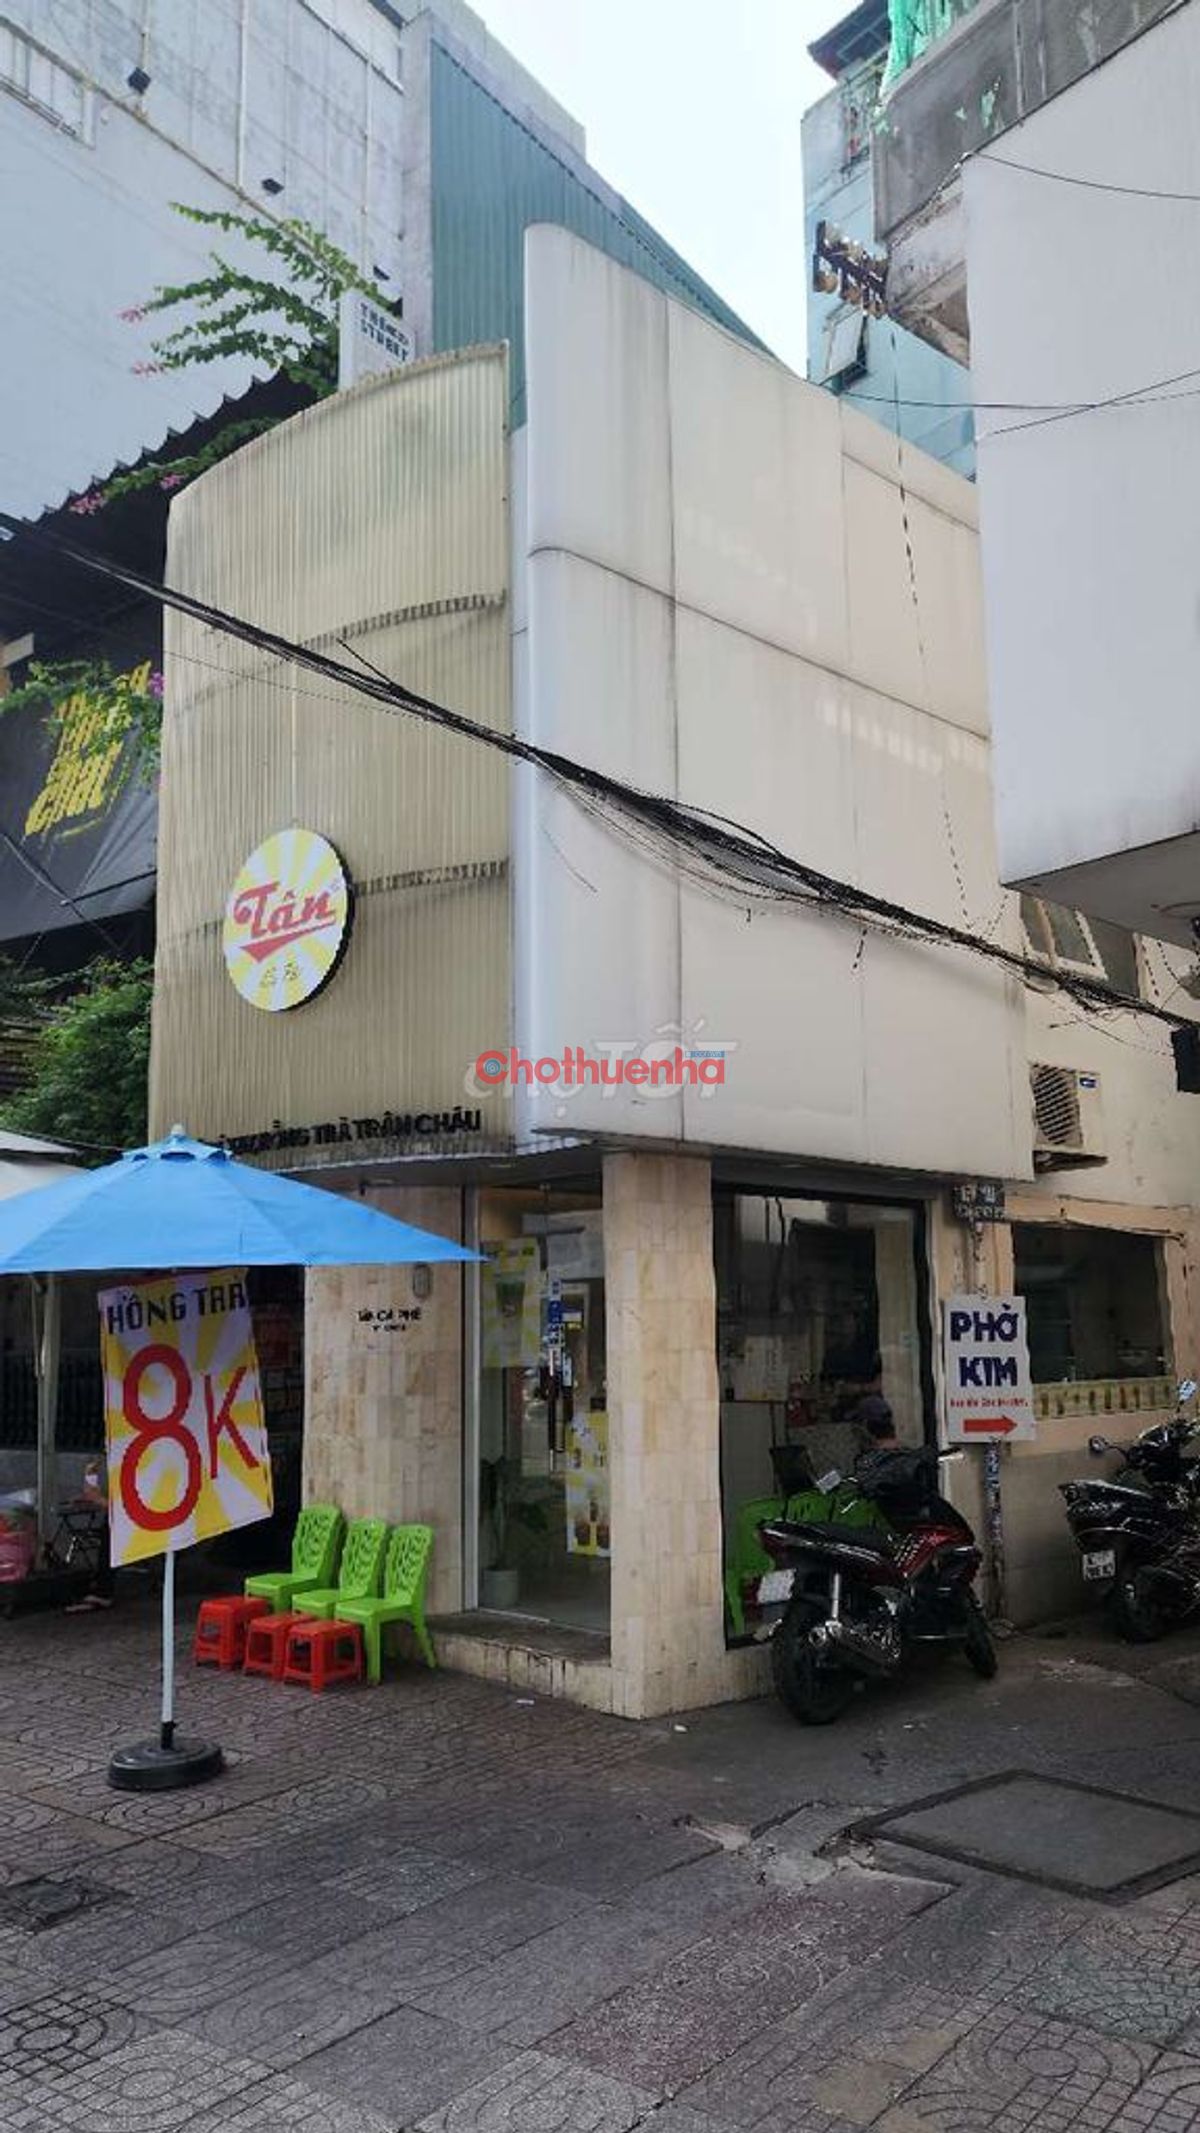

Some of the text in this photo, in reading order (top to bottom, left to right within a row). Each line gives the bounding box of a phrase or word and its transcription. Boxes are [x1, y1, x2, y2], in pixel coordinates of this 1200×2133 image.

[233, 881, 336, 937] Tân
[107, 1291, 186, 1335] HỒNG
[959, 1356, 1018, 1387] KIM
[120, 1343, 260, 1531] 8K
